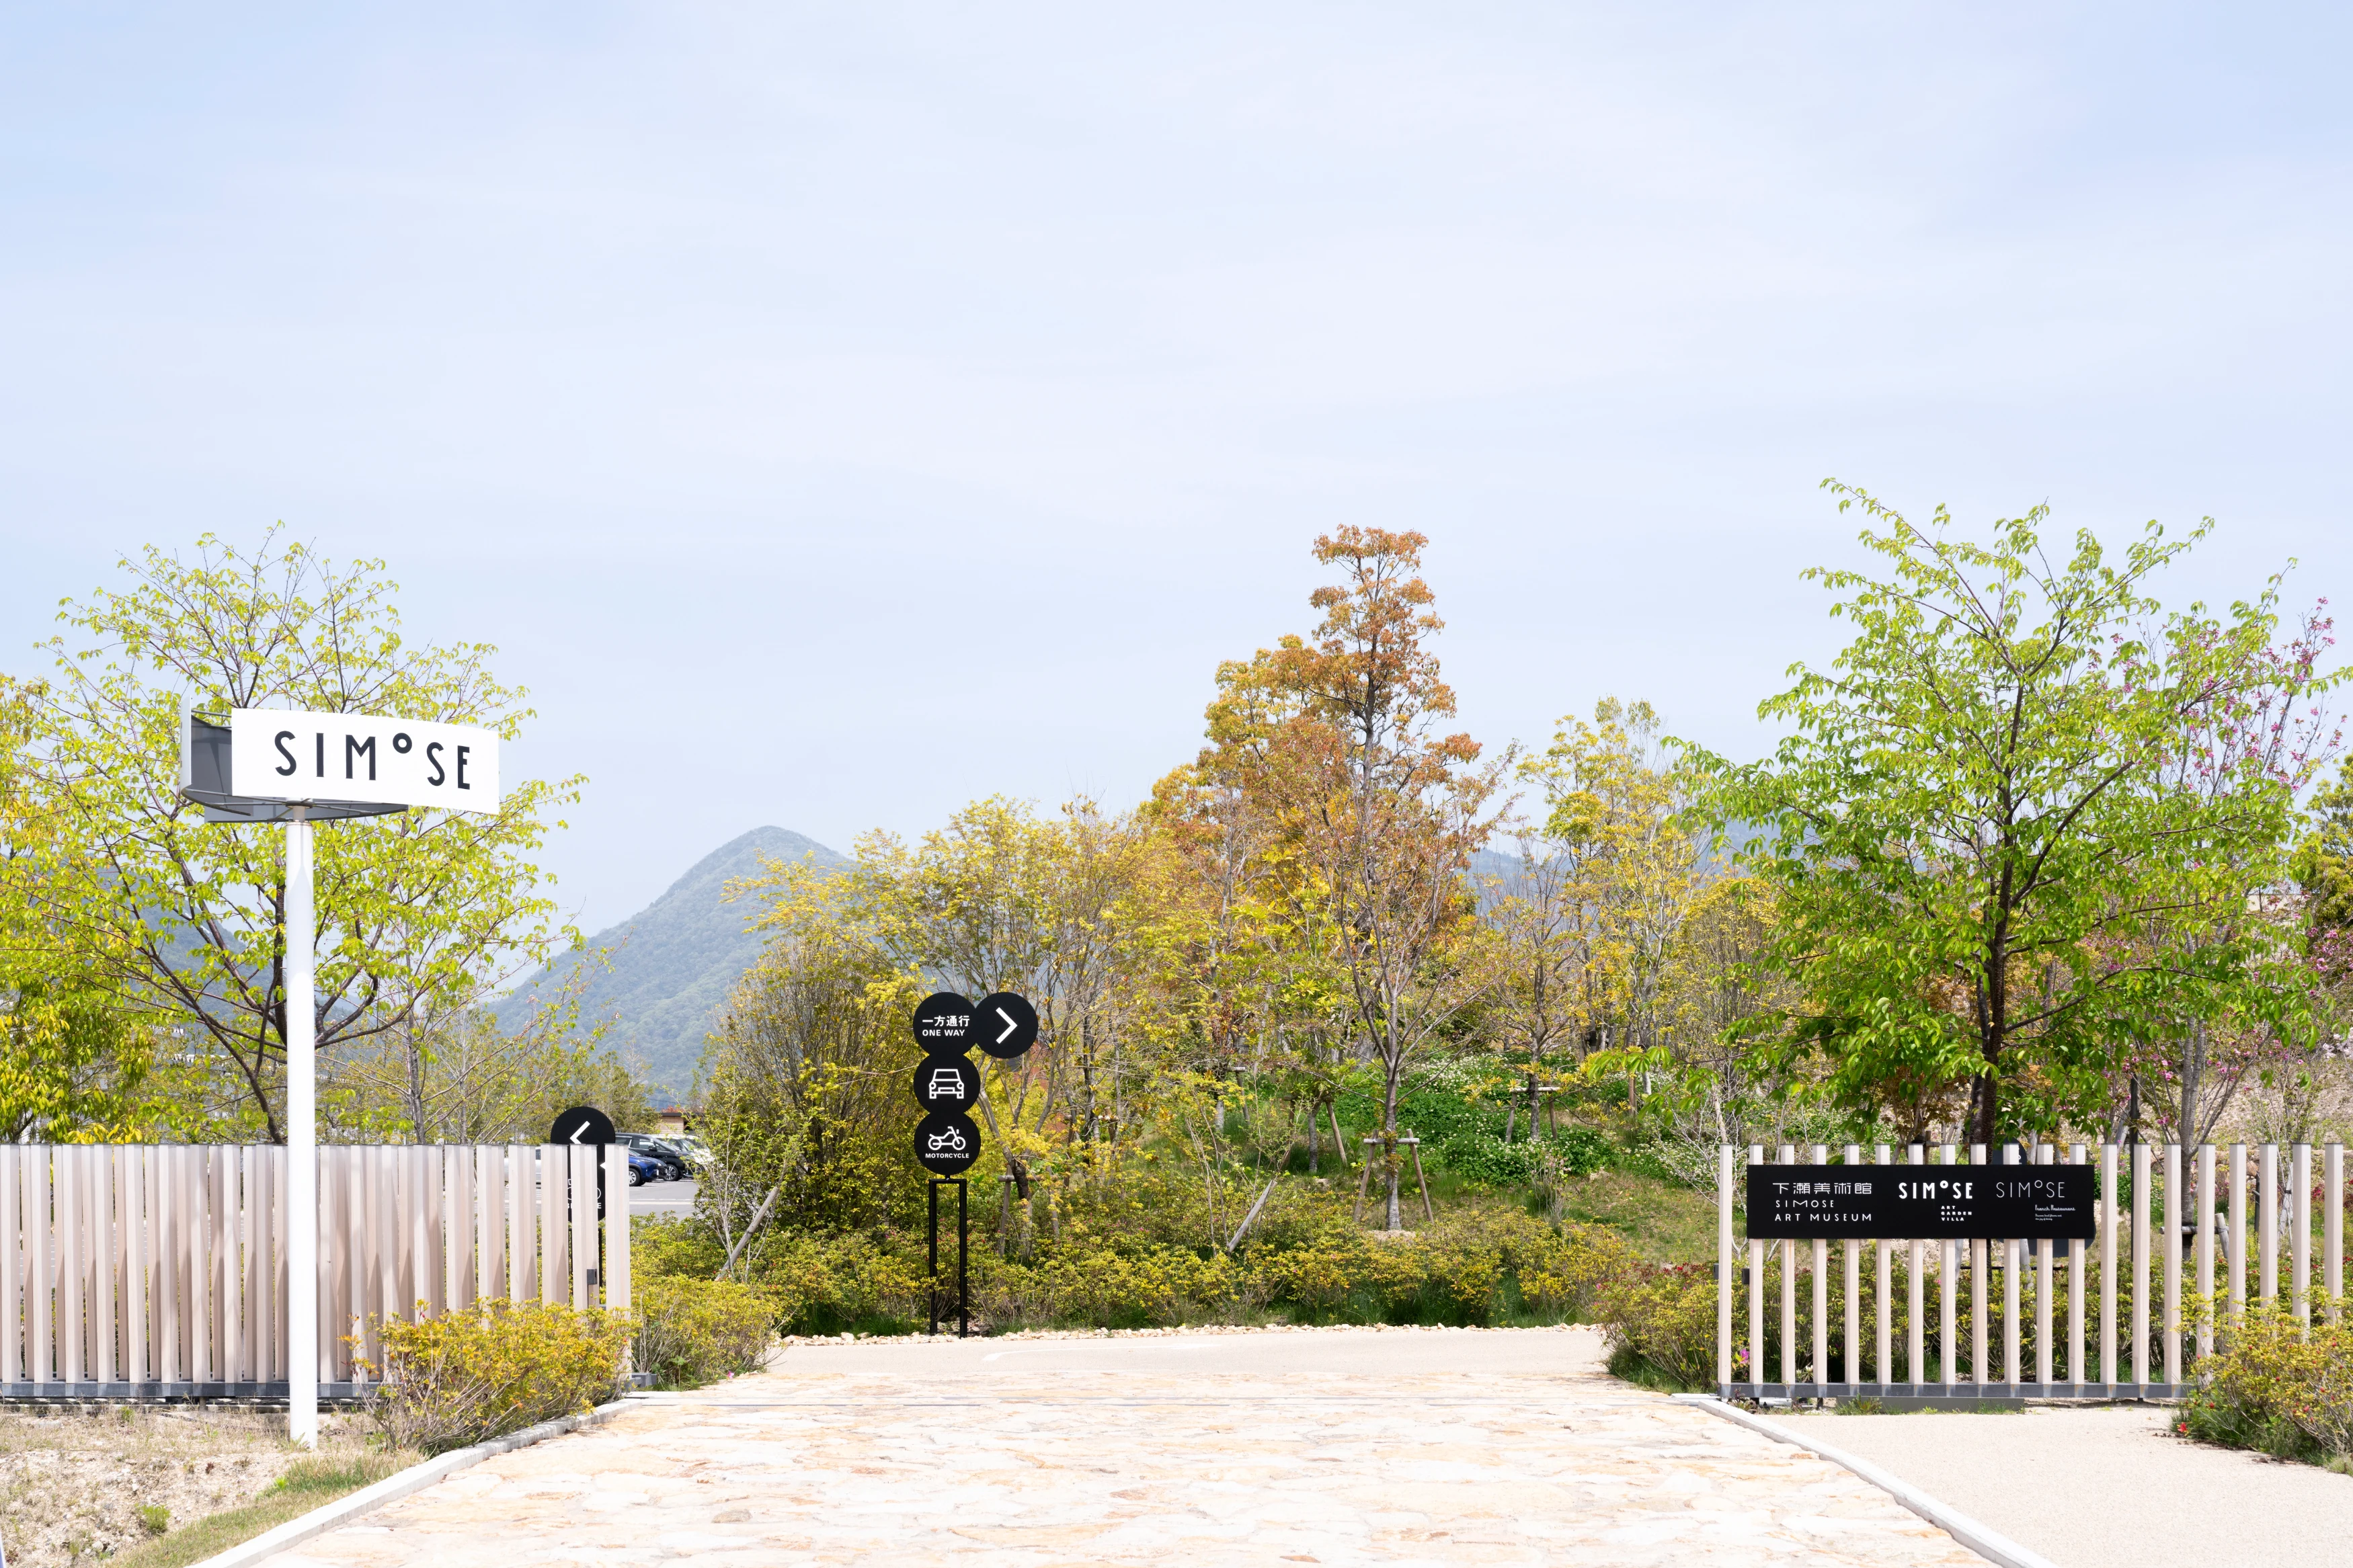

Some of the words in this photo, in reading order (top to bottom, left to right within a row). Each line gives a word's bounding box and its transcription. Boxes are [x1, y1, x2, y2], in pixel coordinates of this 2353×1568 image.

[274, 731, 470, 790] SIMOSE
[922, 1016, 969, 1026] 一方通行
[1899, 1180, 1972, 1199] SIMOSE
[1997, 1180, 2065, 1198] SIMOSE
[1776, 1200, 1834, 1208] SIMOSE
[1774, 1213, 1800, 1221] ART
[1810, 1213, 1872, 1222] MUSEUM
